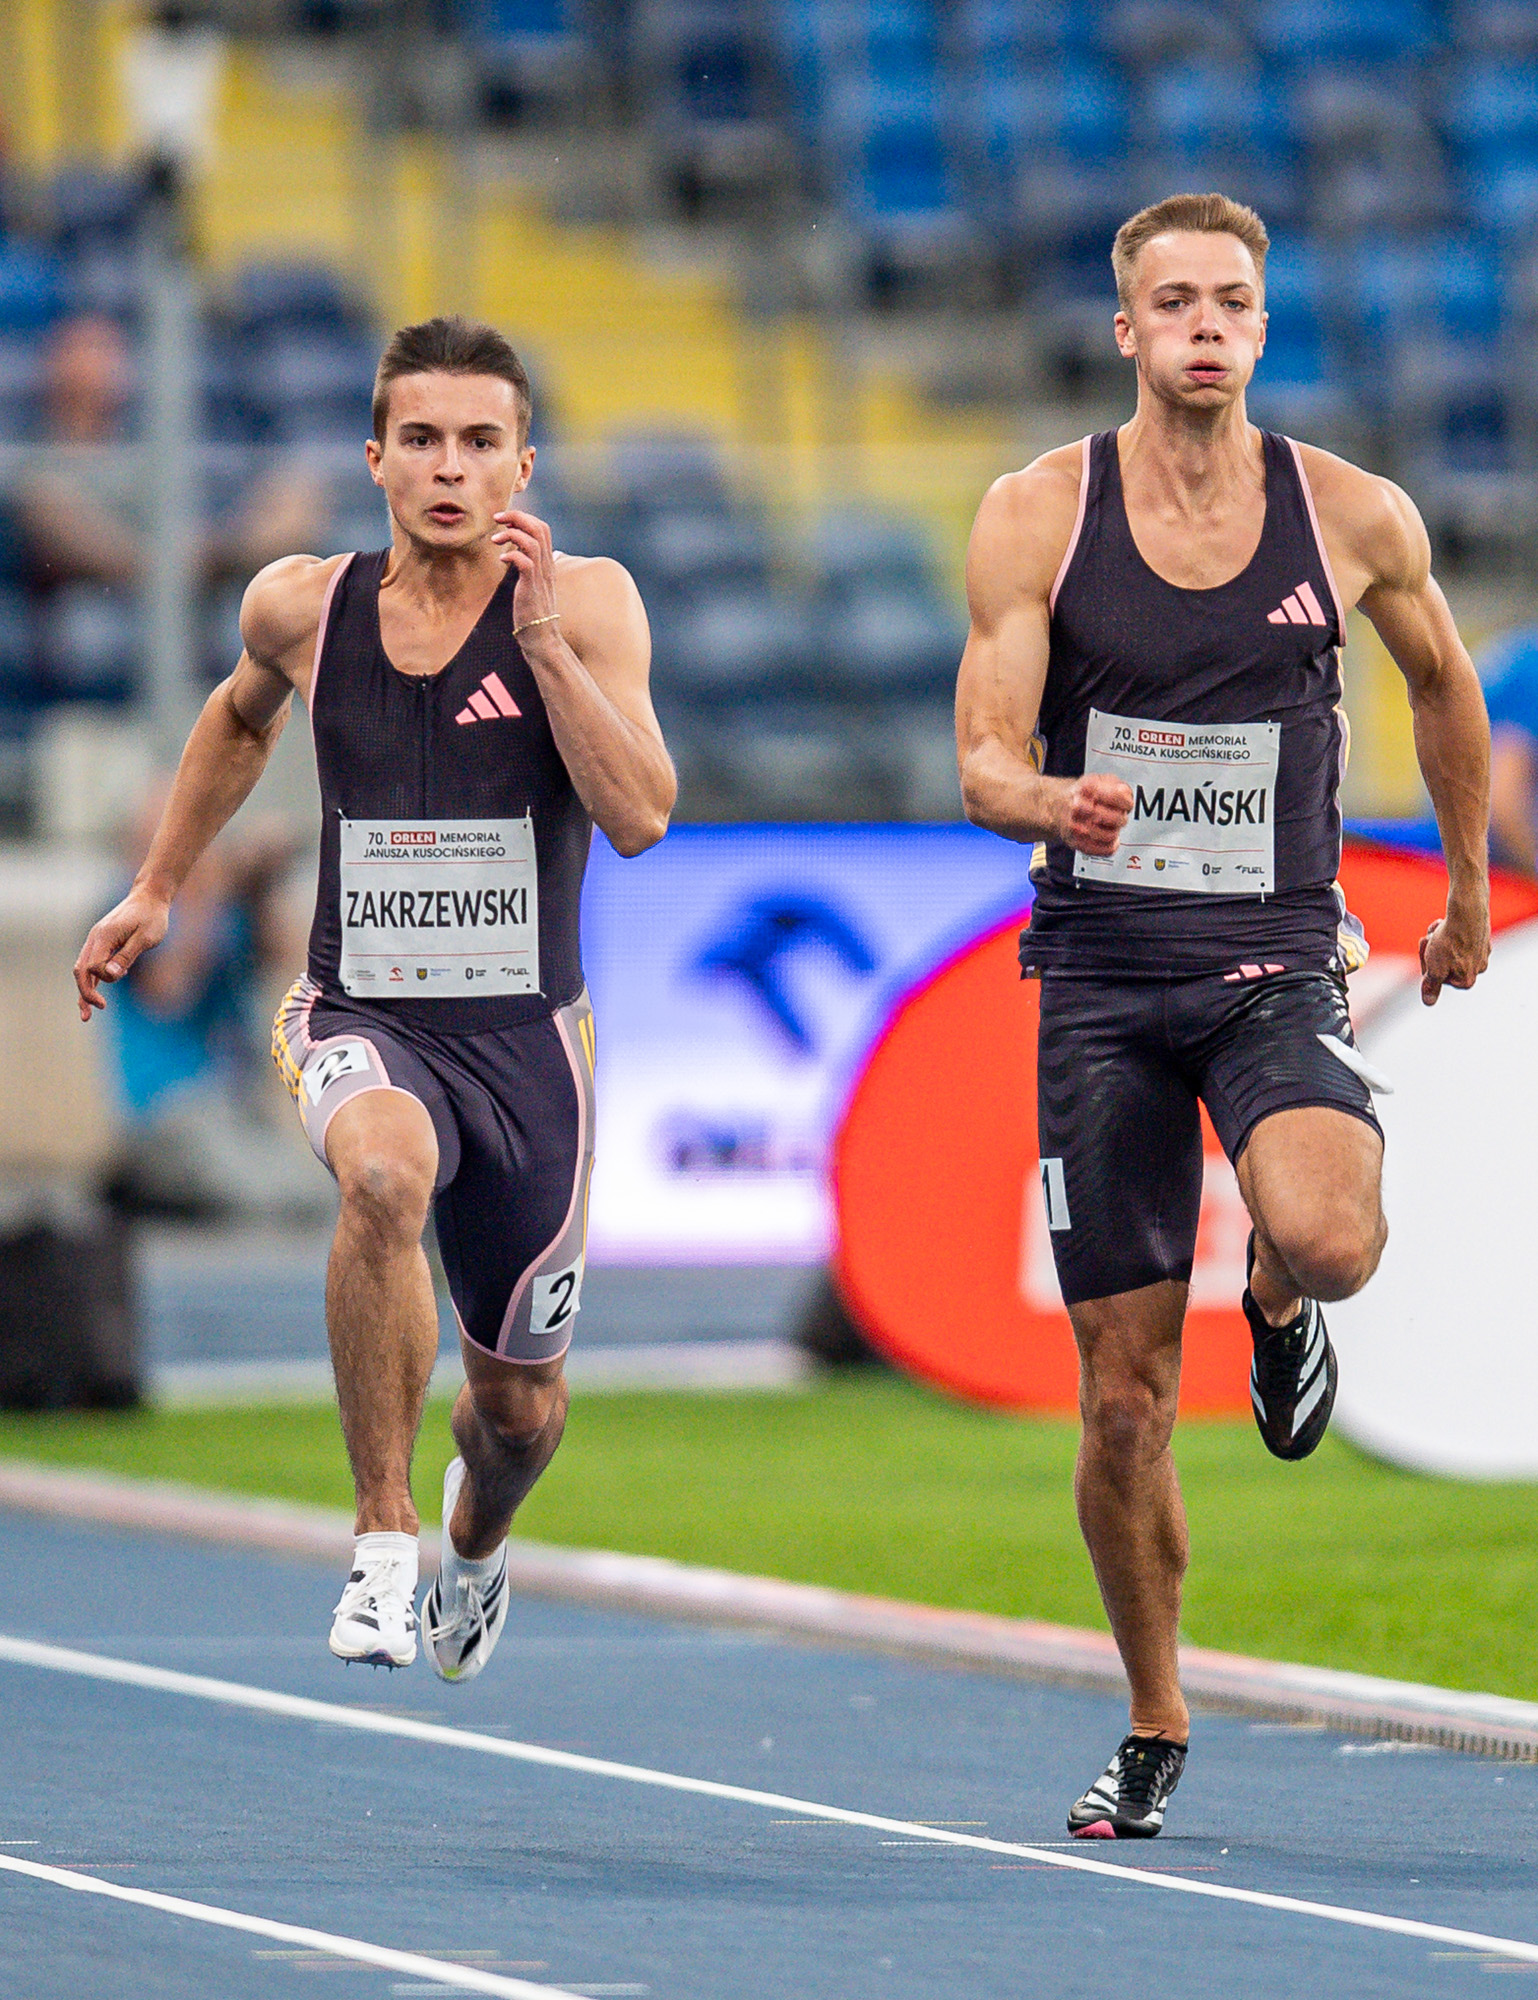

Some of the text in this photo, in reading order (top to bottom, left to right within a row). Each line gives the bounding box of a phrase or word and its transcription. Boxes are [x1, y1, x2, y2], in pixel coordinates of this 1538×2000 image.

[1109, 741, 1250, 760] JANUSZA KUSOCIŃSKIEGO
[1114, 726, 1247, 746] 70. ORLEN MEMORIAŁ
[1133, 780, 1267, 826] MAŃSKI
[363, 845, 506, 859] JANUSZA KUSOCIŃSKIEGO
[368, 832, 502, 845] 70. ORLEN MEMORIAŁ
[346, 887, 528, 928] ZAKRZEWSKI
[316, 1049, 353, 1091] 2
[1041, 1164, 1053, 1225] 1
[545, 1270, 576, 1329] 2
